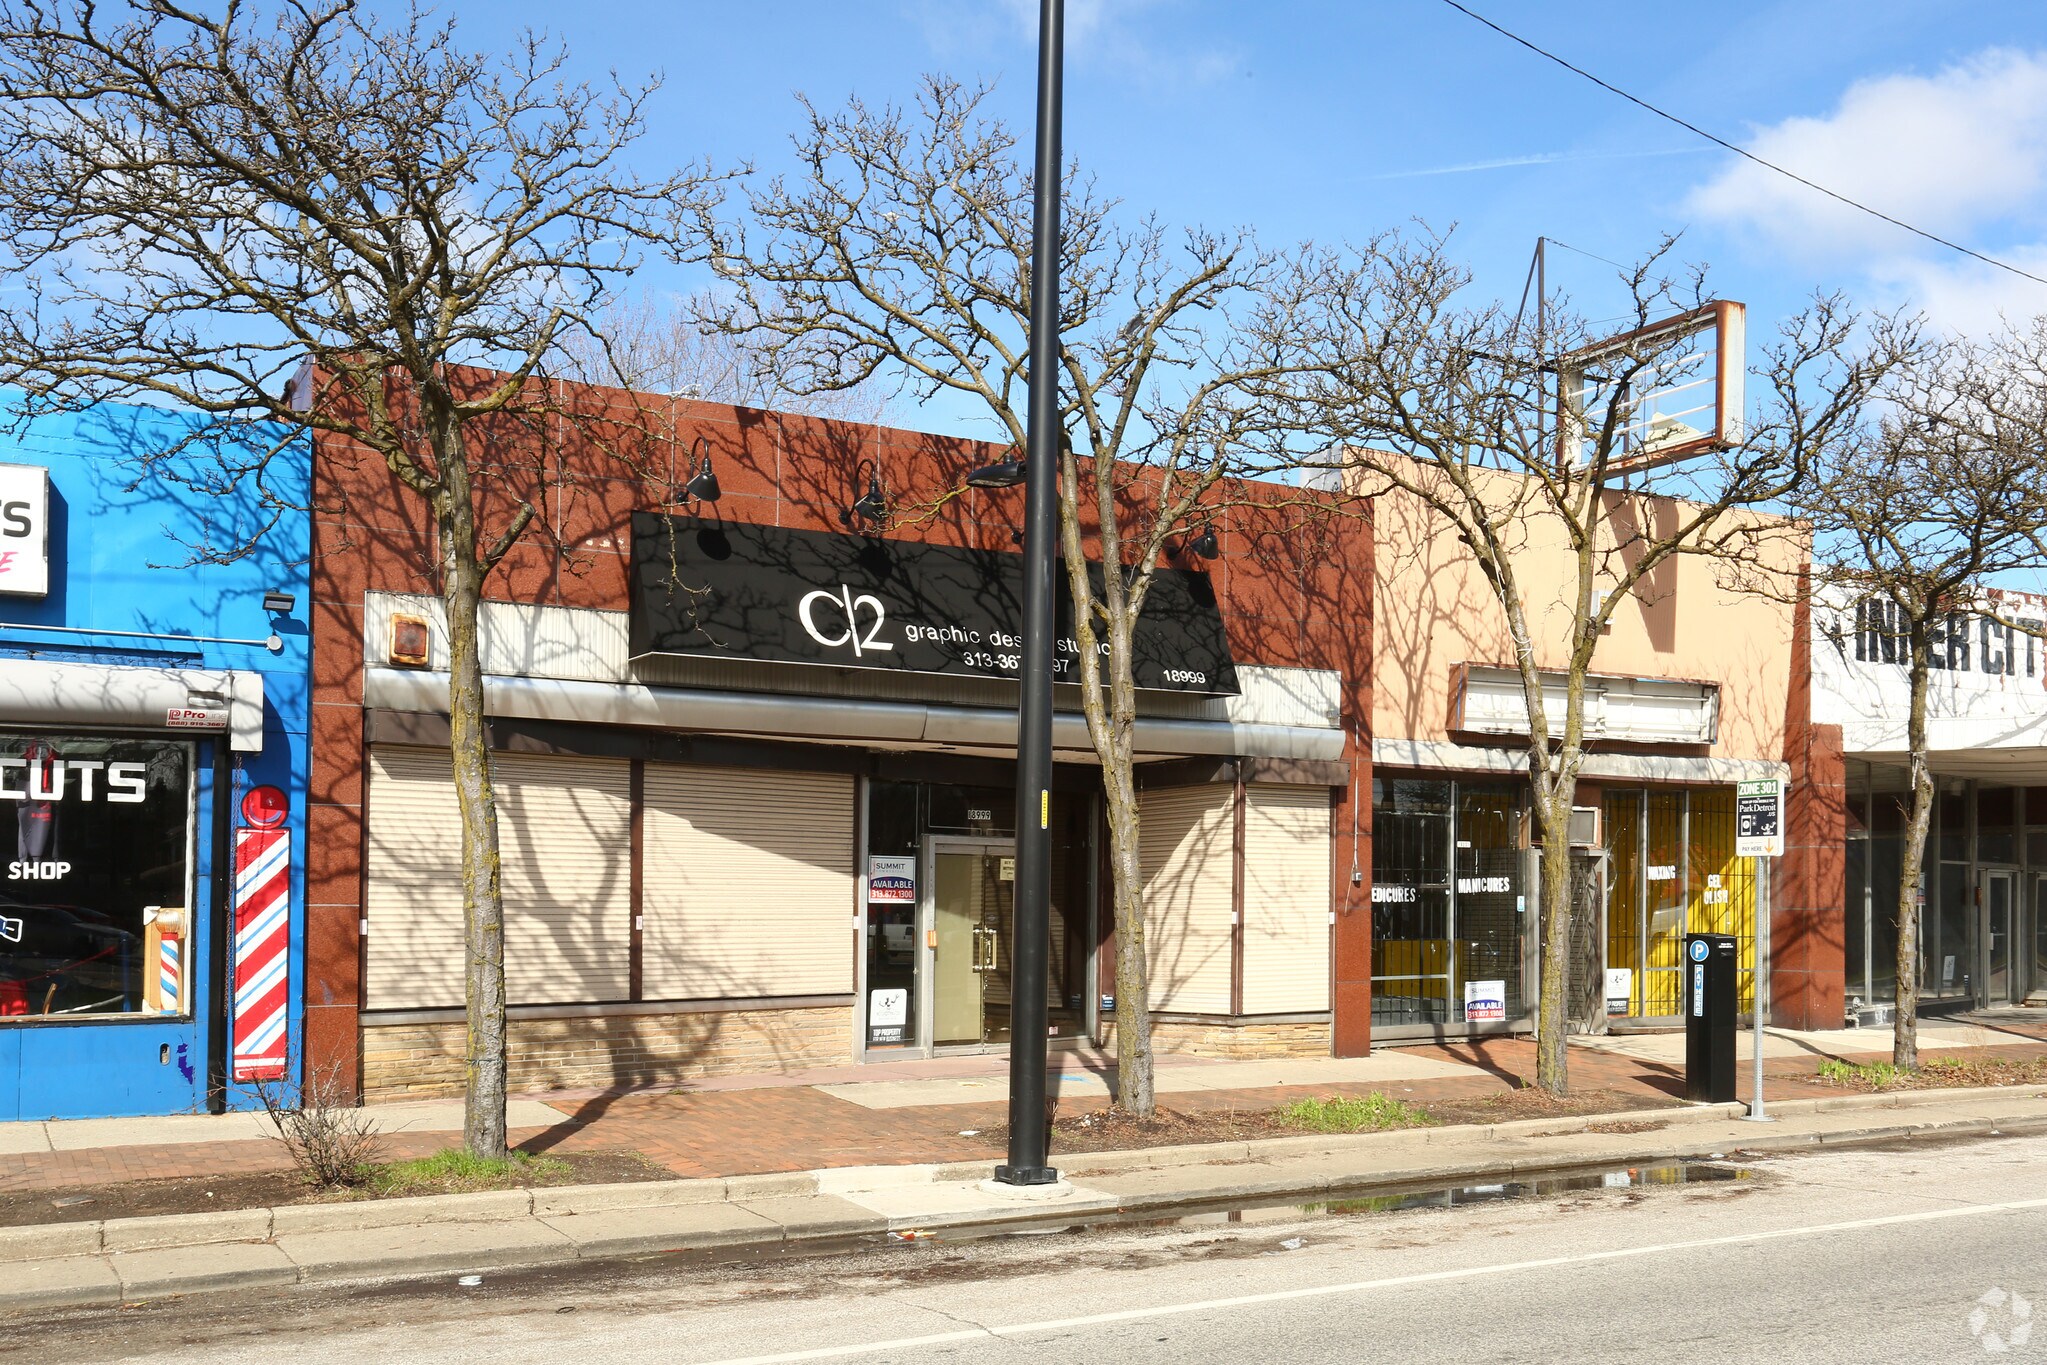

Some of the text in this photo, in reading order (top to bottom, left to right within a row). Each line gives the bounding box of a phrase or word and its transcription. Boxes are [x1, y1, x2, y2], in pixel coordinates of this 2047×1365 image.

[905, 624, 981, 645] graphic
[1057, 637, 1111, 656] stuio
[1163, 669, 1206, 684] 18999
[0, 758, 146, 803] CUTS
[1739, 781, 1777, 795] ZONE 301
[968, 810, 991, 820] 18999
[8, 861, 71, 880] SHOP
[1648, 865, 1676, 880] WAXING
[872, 880, 913, 889] AVAILABLE
[1457, 876, 1510, 894] MANICURES
[1707, 874, 1721, 888] GEL
[871, 889, 913, 898] 313.872.1300
[1372, 887, 1416, 903] EDICURES
[1469, 1001, 1503, 1010] AVAILABLE
